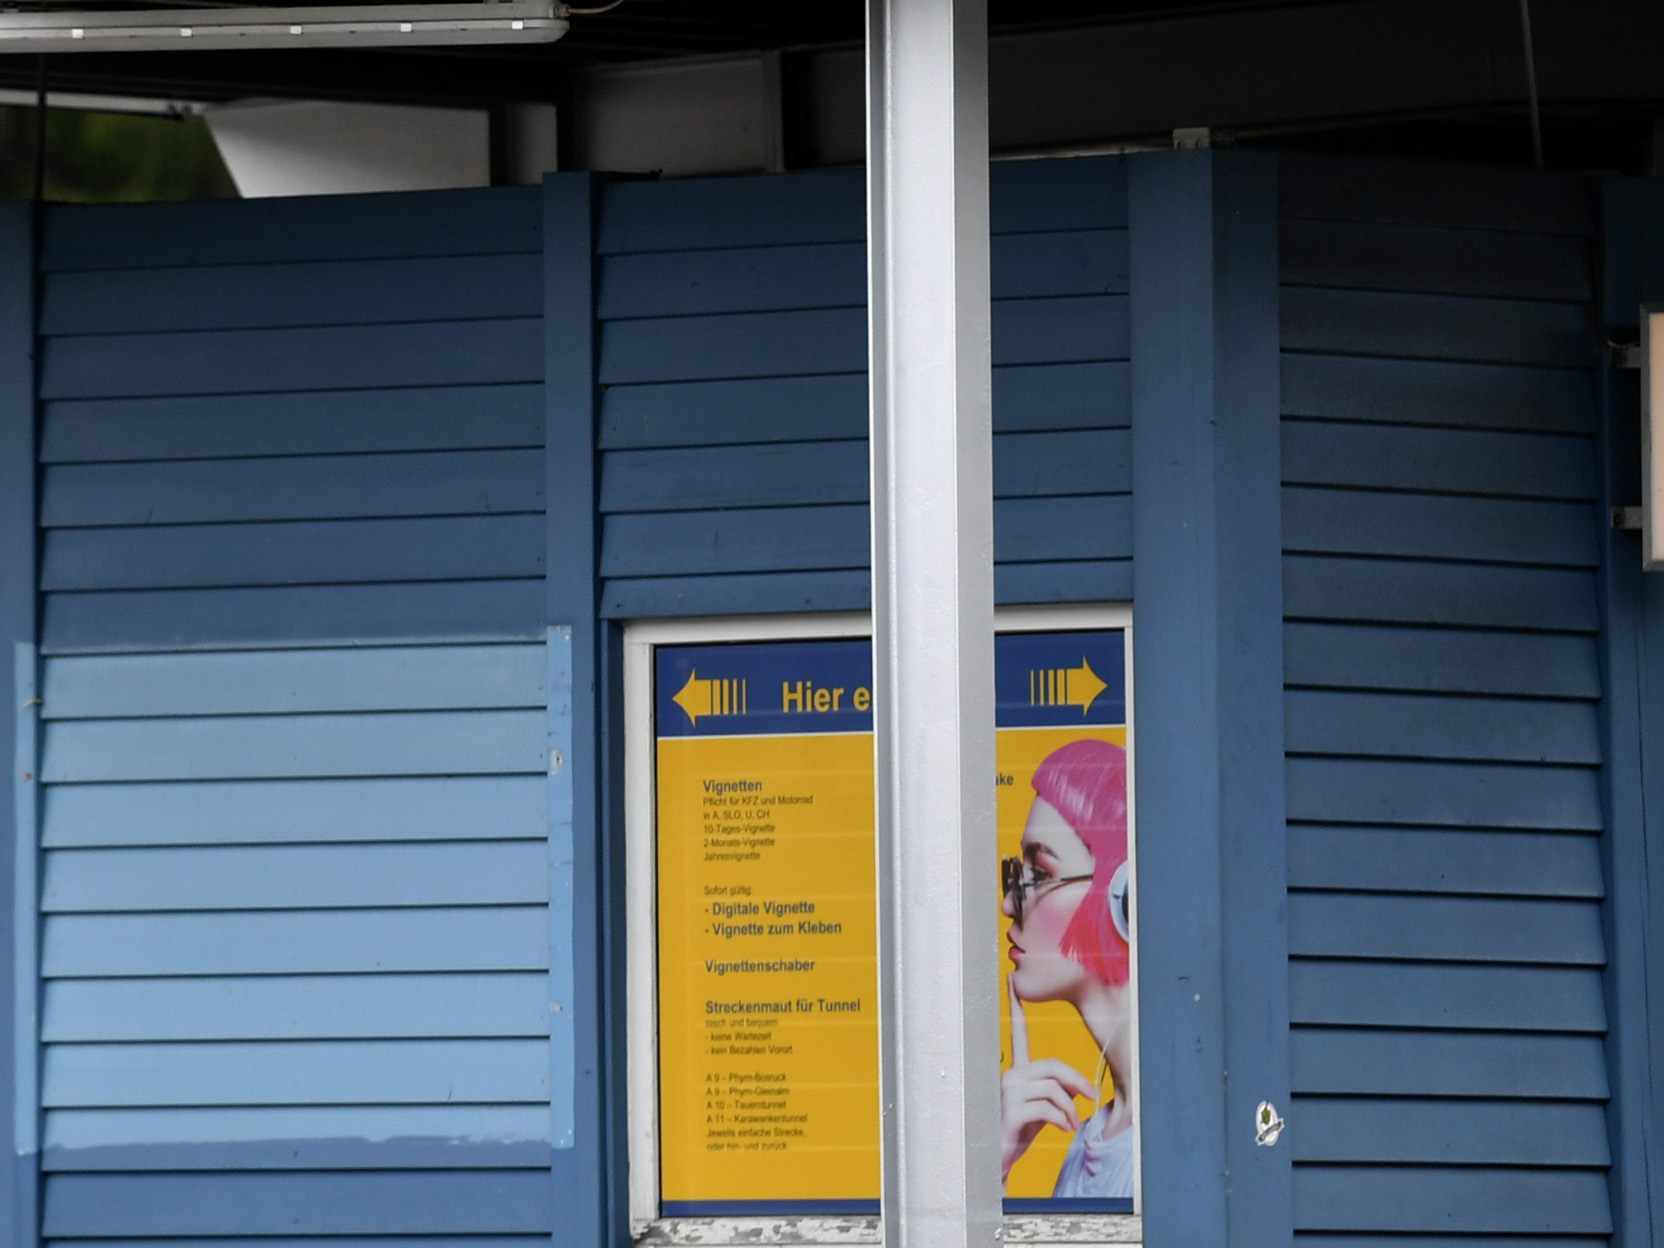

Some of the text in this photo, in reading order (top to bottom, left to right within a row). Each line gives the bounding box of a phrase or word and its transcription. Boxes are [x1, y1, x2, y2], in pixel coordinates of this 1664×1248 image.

[782, 681, 845, 713] Hier
[703, 779, 763, 796] Vignetten
[778, 795, 814, 806] Motorrad
[712, 902, 760, 919] Digitale
[762, 901, 816, 918] Vignette
[712, 922, 765, 939] Vignette
[767, 925, 794, 936] zum
[798, 920, 843, 935] Kleben
[704, 959, 816, 976] Vignettenschaber
[705, 998, 862, 1015] Streckenmaut für Tunnel
